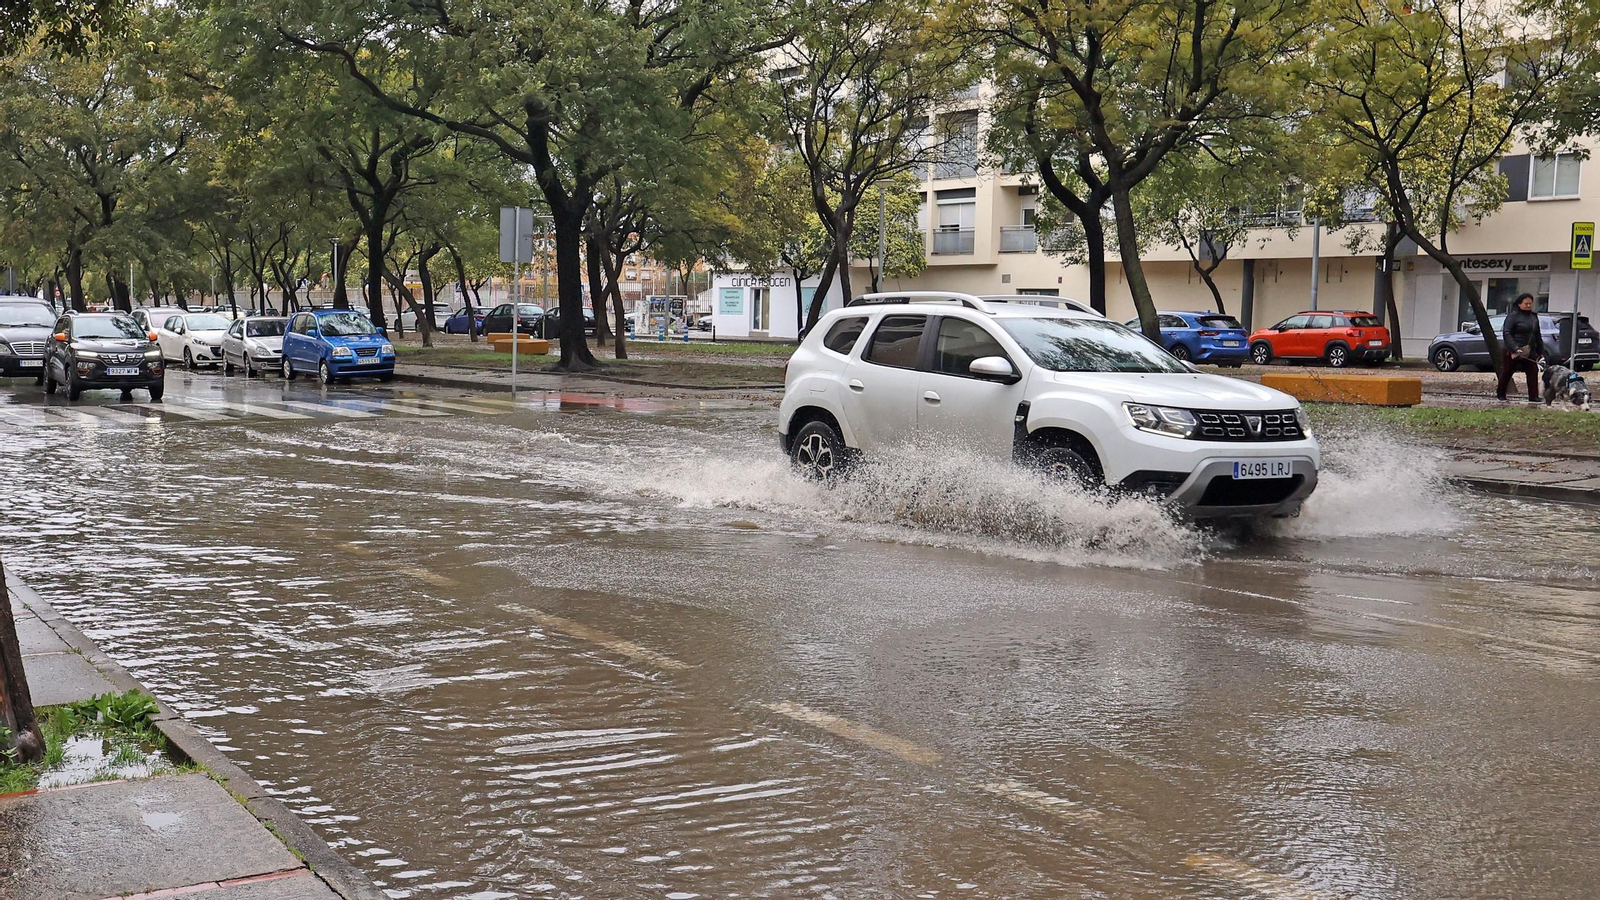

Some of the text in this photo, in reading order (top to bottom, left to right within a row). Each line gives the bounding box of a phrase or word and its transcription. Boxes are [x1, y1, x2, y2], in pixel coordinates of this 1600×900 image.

[1443, 258, 1512, 271] ntesexy
[1240, 462, 1291, 477] 6495 LRJ
